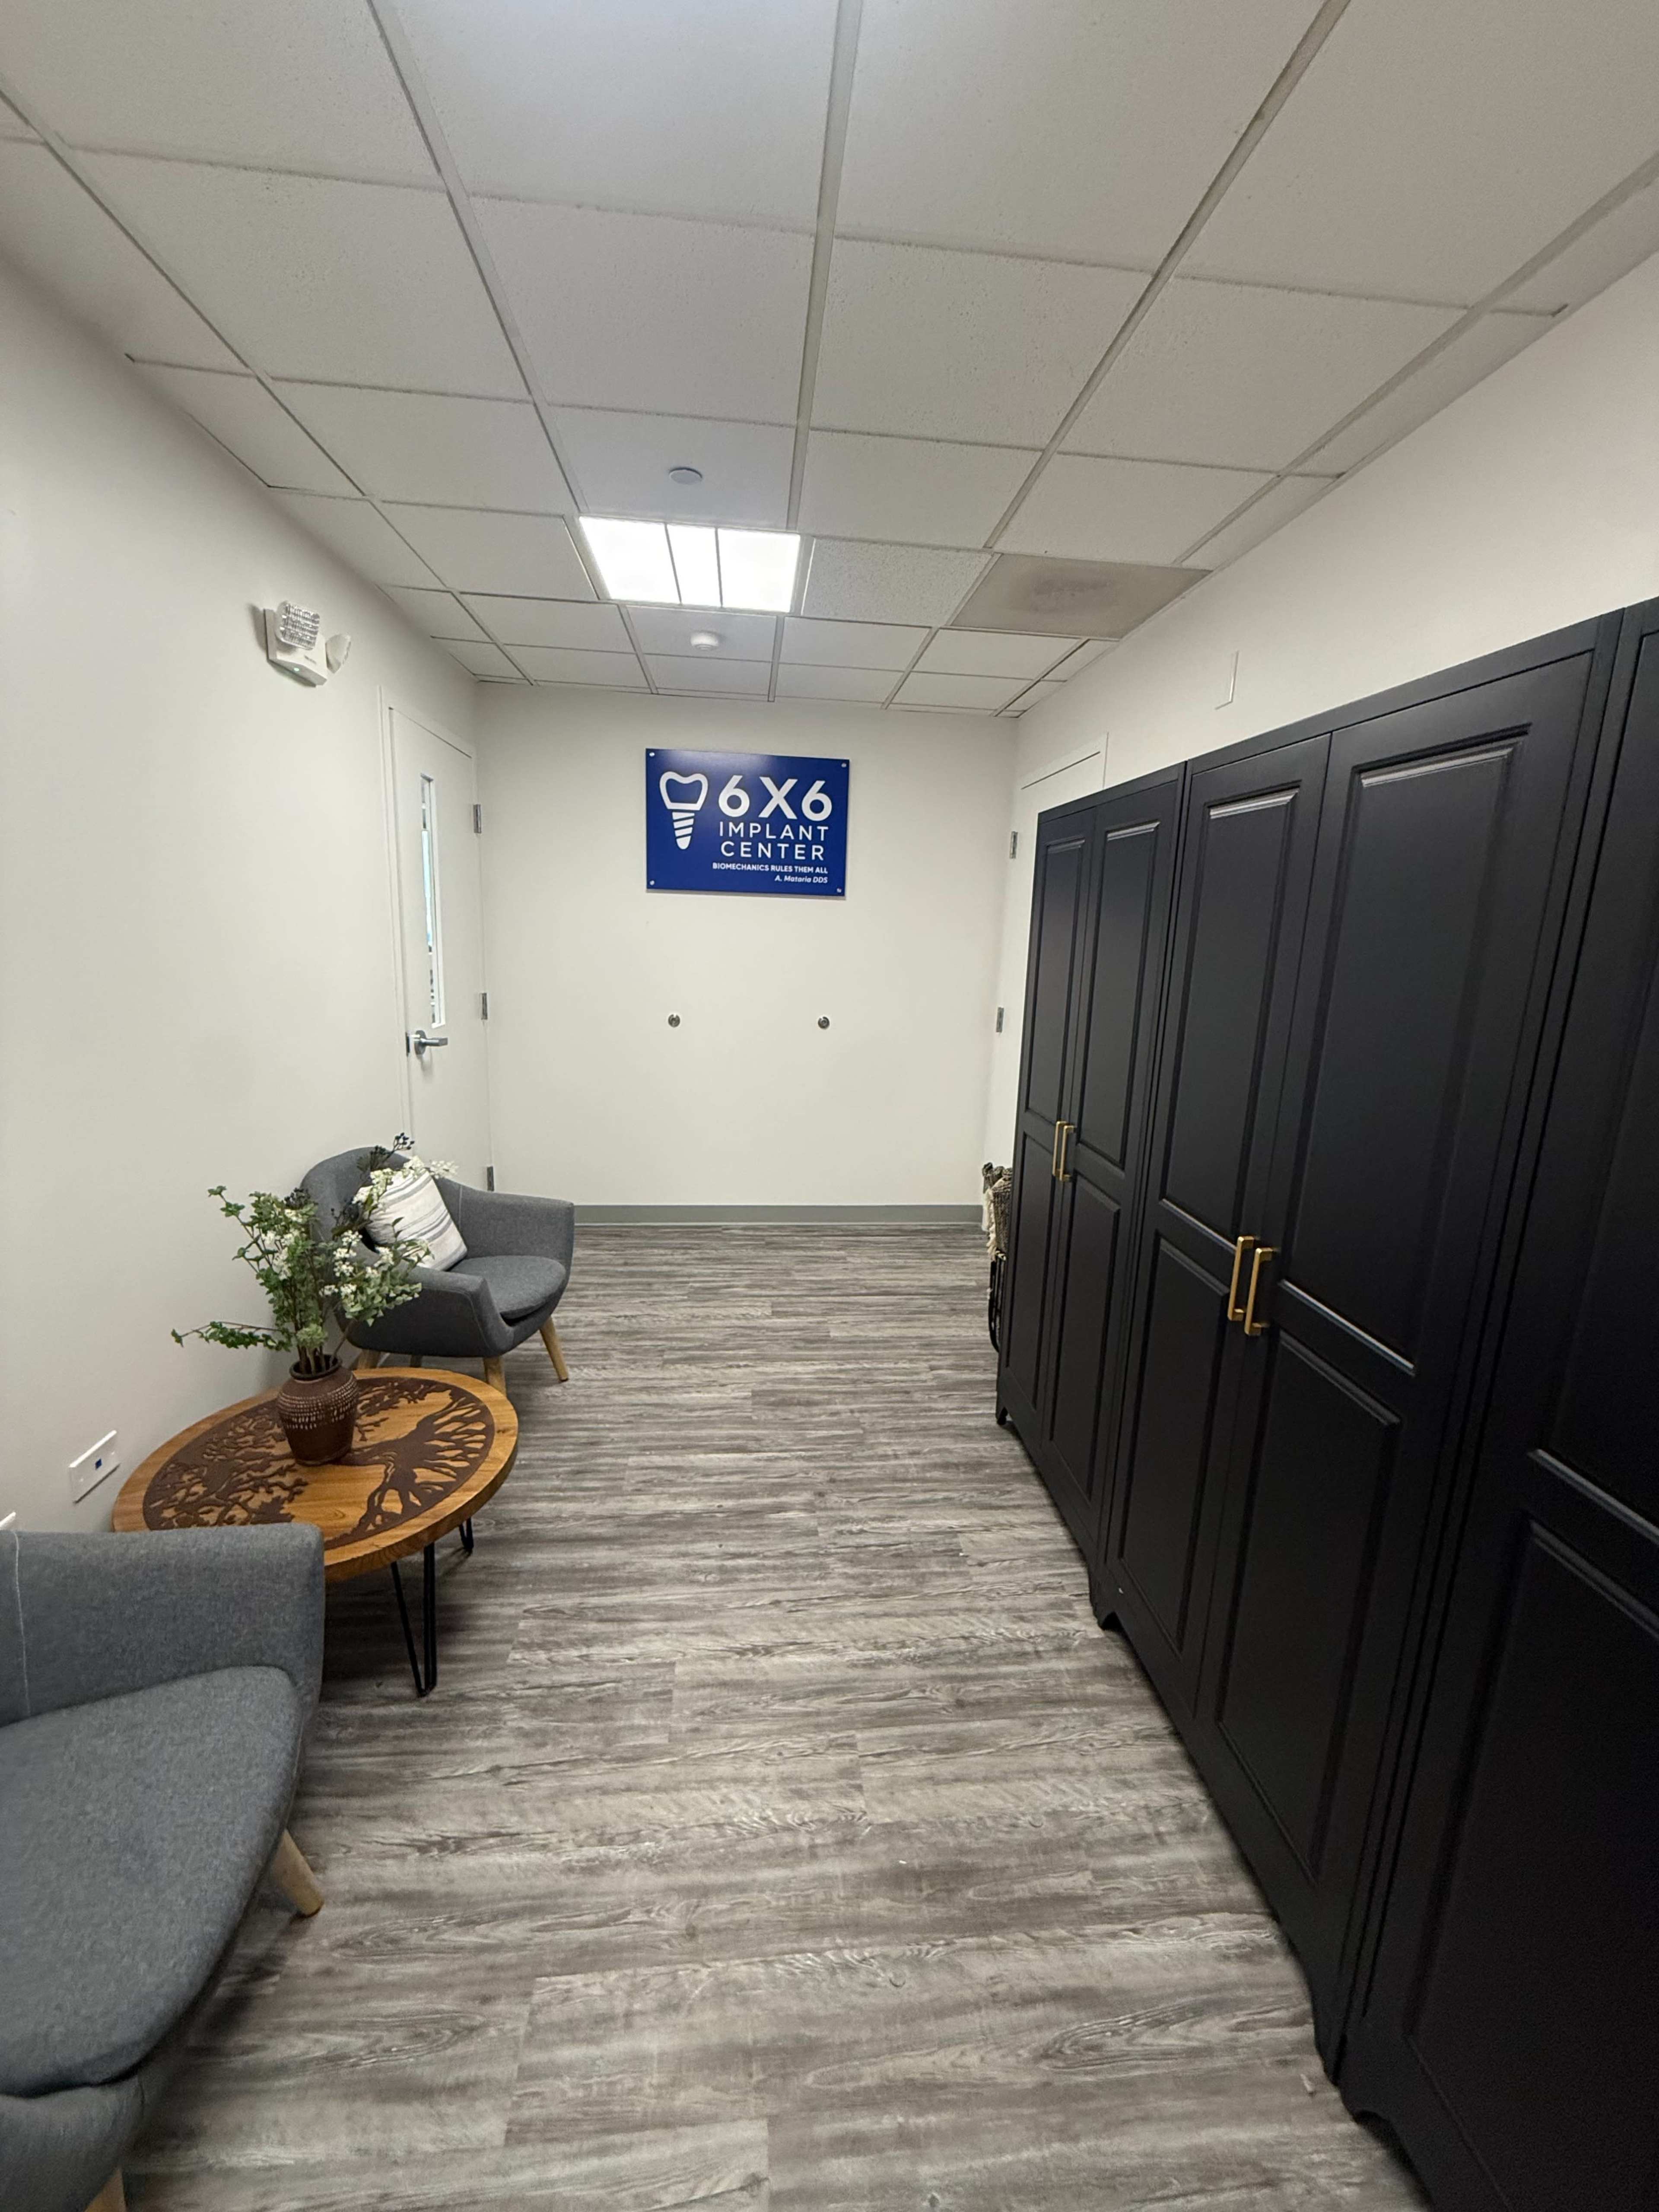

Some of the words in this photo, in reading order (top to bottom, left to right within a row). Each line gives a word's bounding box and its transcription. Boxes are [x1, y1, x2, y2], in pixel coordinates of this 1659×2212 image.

[719, 821, 829, 841] IMPLANT
[721, 841, 823, 861] CENTER
[712, 862, 769, 872] BIOMECHANICS
